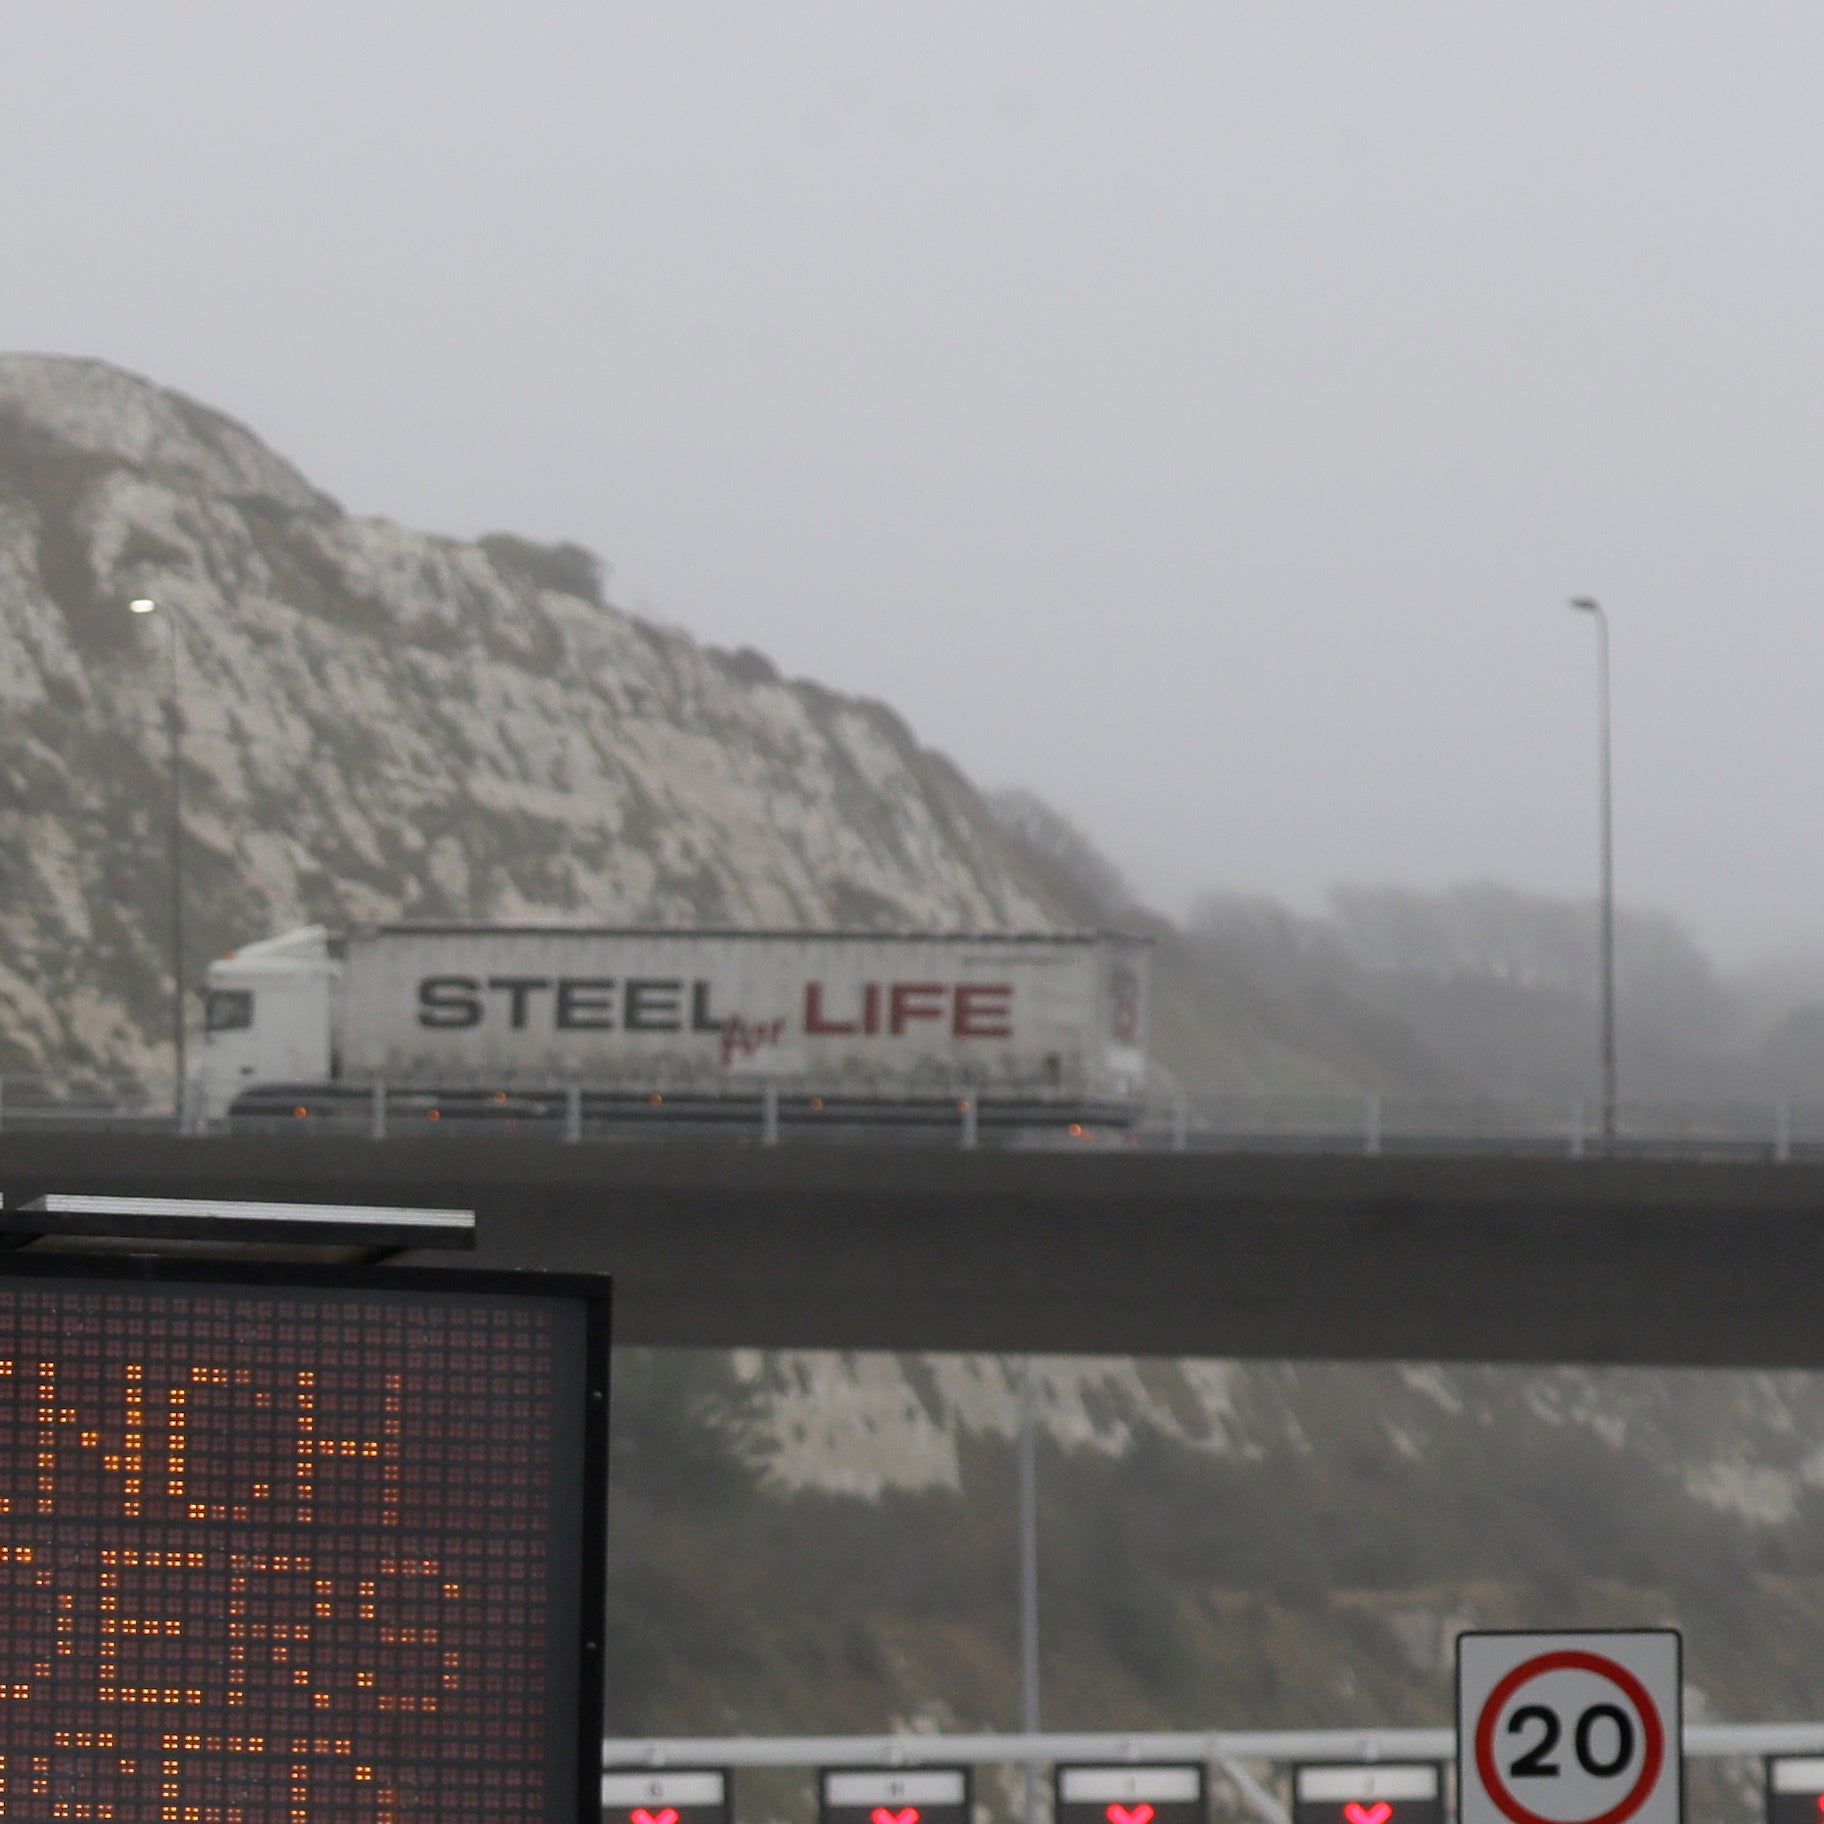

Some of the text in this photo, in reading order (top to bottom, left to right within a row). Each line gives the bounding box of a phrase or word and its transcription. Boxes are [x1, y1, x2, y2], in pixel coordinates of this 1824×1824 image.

[416, 974, 727, 1032] STEEL
[805, 980, 1016, 1037] LIFE
[1507, 1704, 1635, 1778] 20
